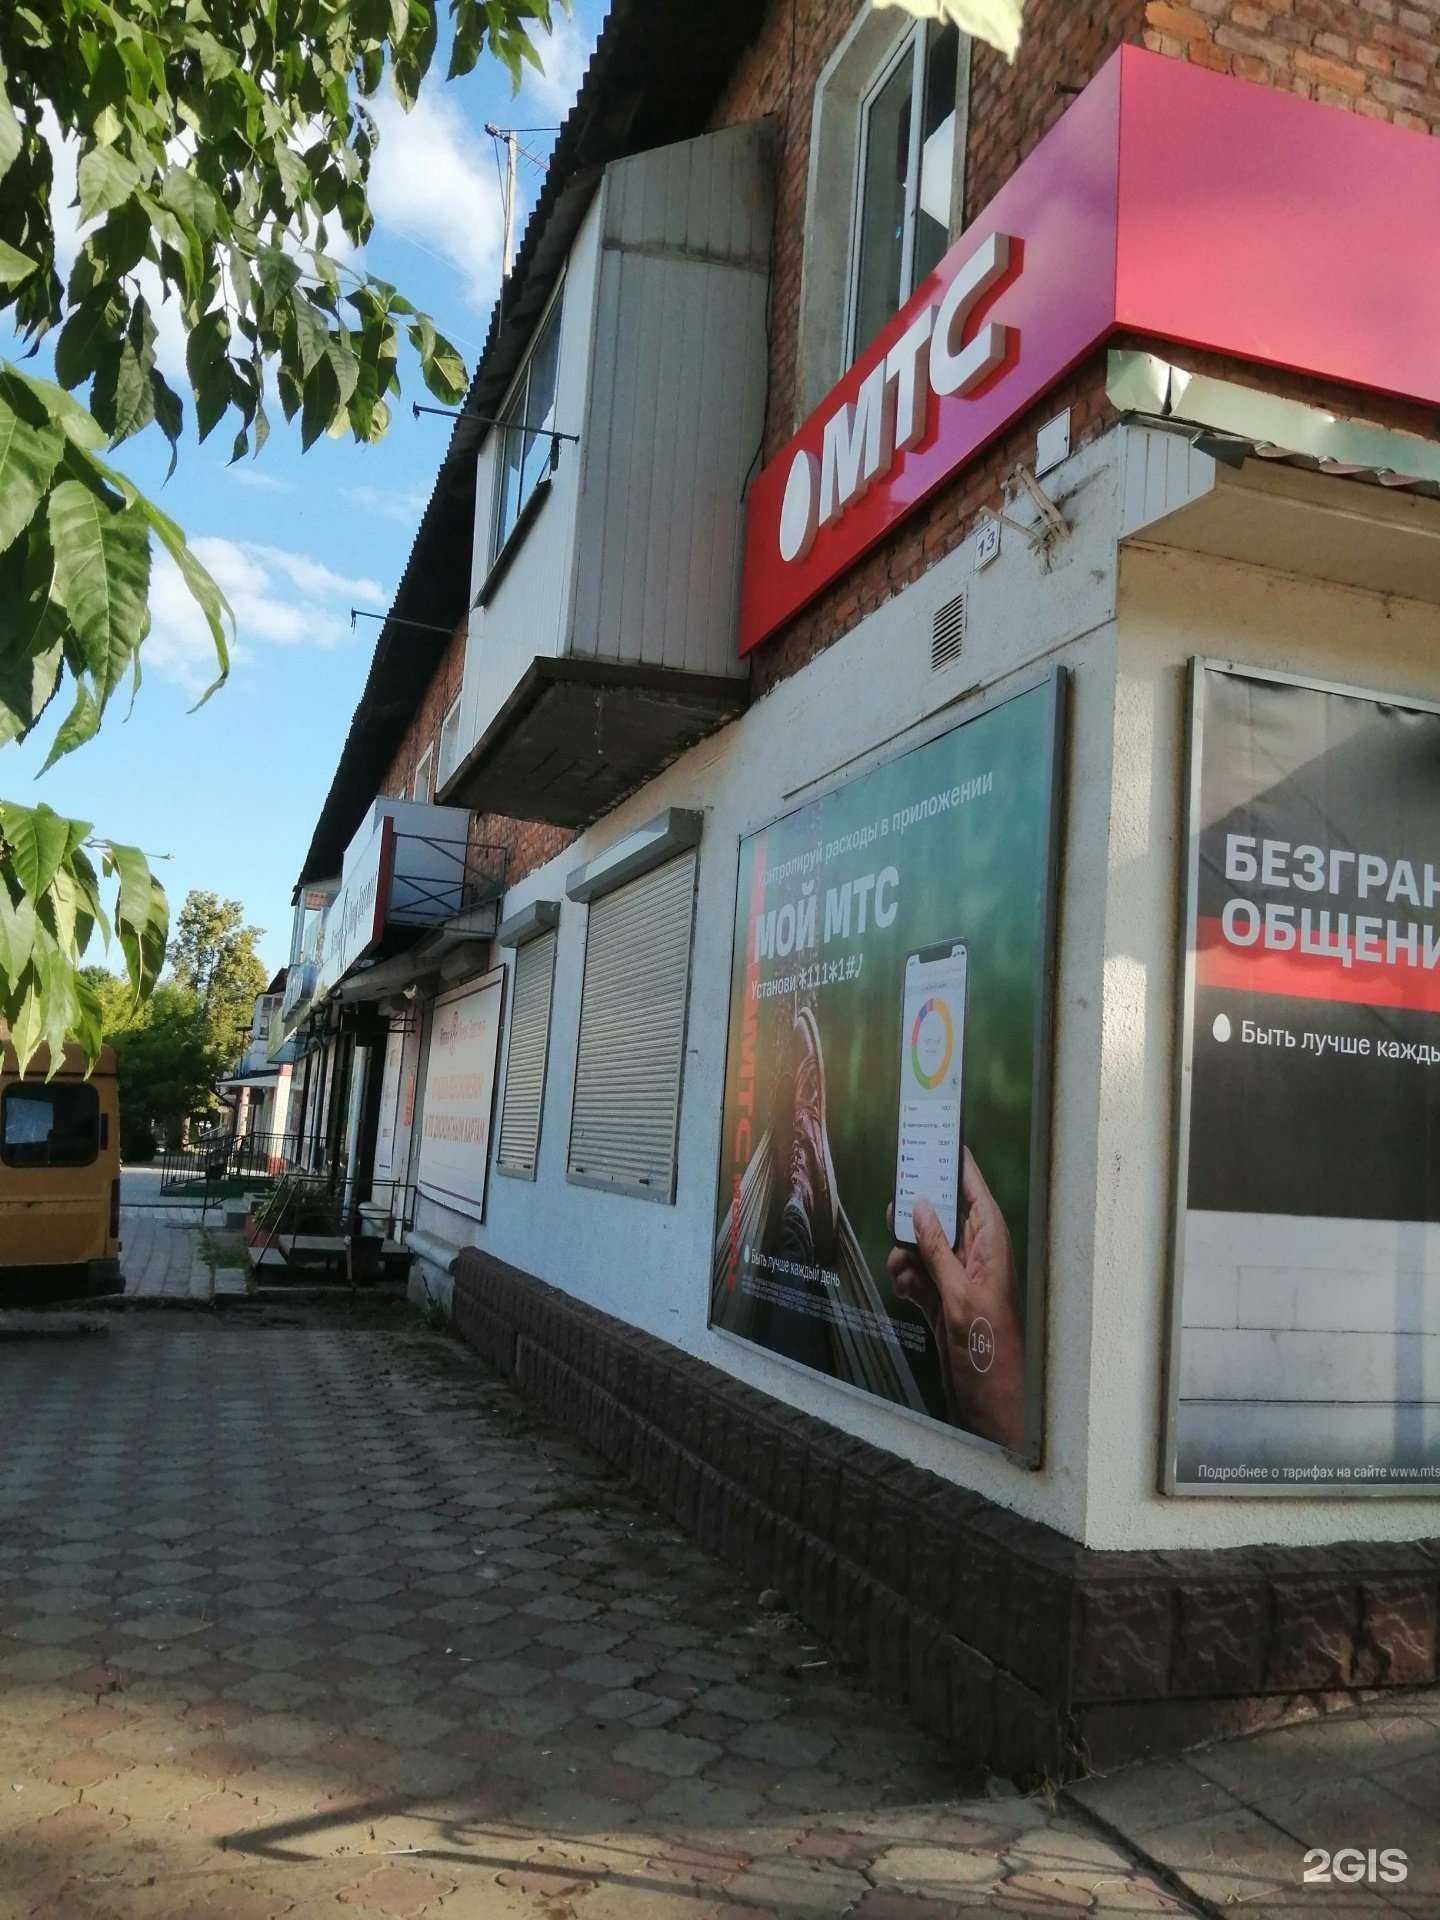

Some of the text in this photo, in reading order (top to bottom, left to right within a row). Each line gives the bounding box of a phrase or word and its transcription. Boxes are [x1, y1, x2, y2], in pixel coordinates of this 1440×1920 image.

[818, 231, 1012, 528] МТС
[977, 530, 995, 558] 13
[825, 822, 878, 864] расходы
[881, 818, 889, 837] в
[893, 771, 993, 835] приложении
[754, 866, 899, 963] МОЙ МТС
[751, 974, 797, 1000] Установи
[1241, 1020, 1296, 1048] Быть
[1301, 1030, 1371, 1056] лучше
[751, 1248, 841, 1288] Быть лучше каждый день
[971, 1331, 993, 1355] 16+
[1198, 1464, 1268, 1480] Подробнее
[1271, 1468, 1280, 1478] о
[1282, 1465, 1334, 1480] тарифах
[1337, 1468, 1350, 1478] на
[1353, 1465, 1387, 1478] сайте
